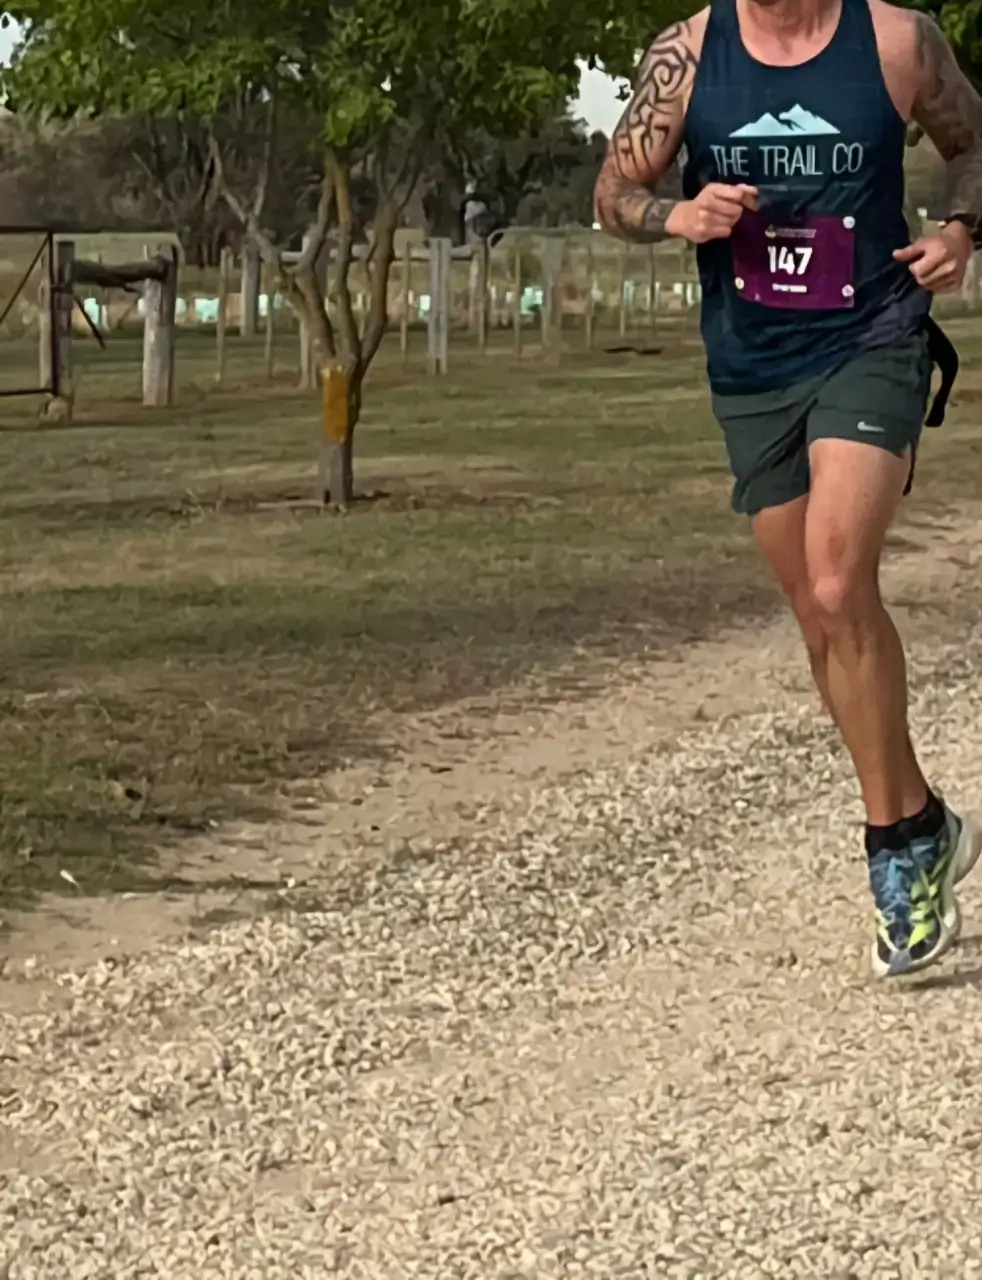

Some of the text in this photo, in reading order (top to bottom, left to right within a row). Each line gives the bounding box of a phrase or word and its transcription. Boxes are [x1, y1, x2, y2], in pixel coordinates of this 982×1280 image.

[709, 142, 864, 177] THE TRAIL CO
[767, 246, 813, 275] 147
